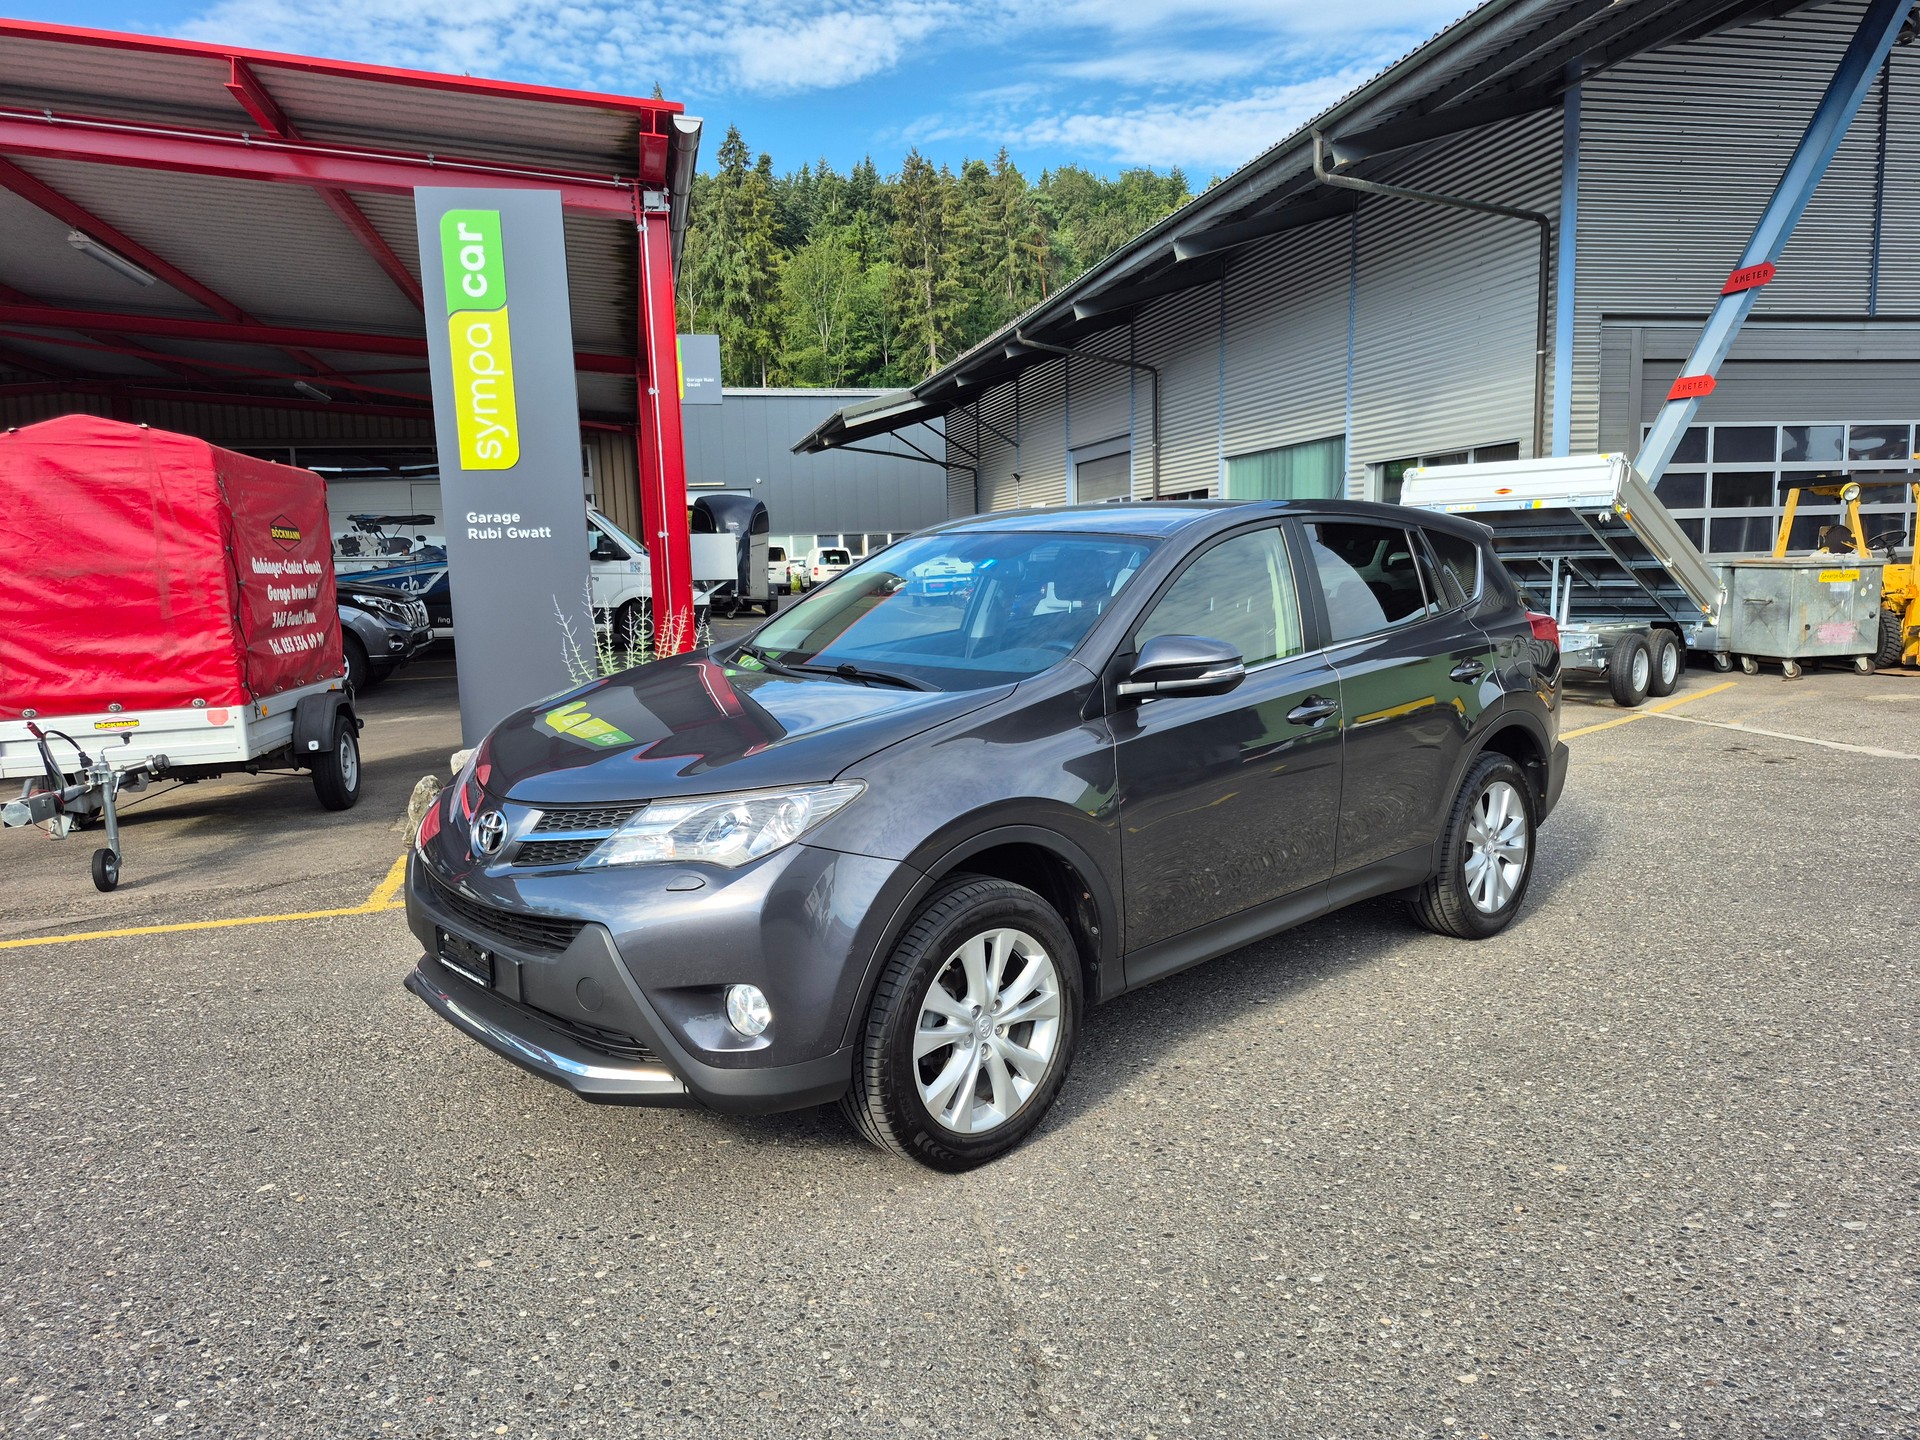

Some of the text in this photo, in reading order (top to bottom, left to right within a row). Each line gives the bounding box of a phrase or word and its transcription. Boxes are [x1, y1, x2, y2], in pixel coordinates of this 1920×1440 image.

[457, 221, 510, 460] sympa car
[466, 512, 521, 525] Garage
[271, 526, 301, 540] BÖCKMANN
[467, 526, 552, 540] Rubi Gwatt
[267, 583, 291, 605] Garage
[280, 636, 296, 654] 033
